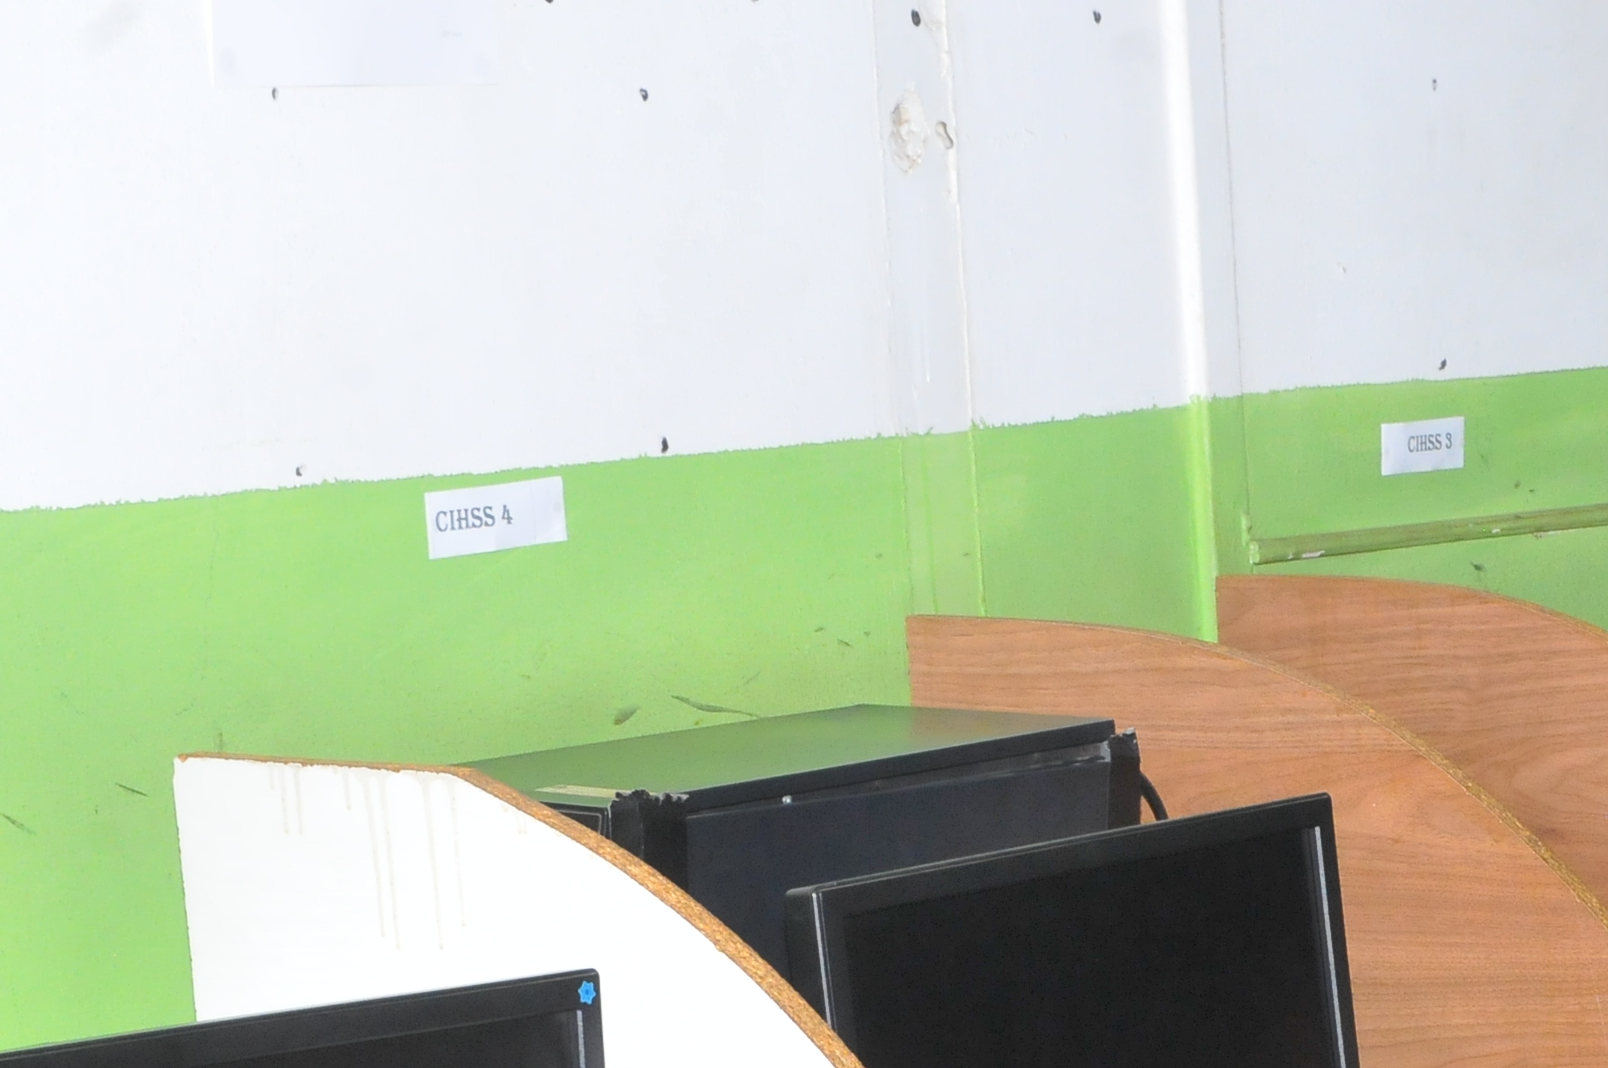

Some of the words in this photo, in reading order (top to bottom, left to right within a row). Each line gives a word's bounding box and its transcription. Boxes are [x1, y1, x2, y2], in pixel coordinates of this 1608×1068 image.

[1407, 433, 1442, 453] CIHSS
[435, 506, 496, 532] CIHSS
[501, 504, 513, 525] 4
